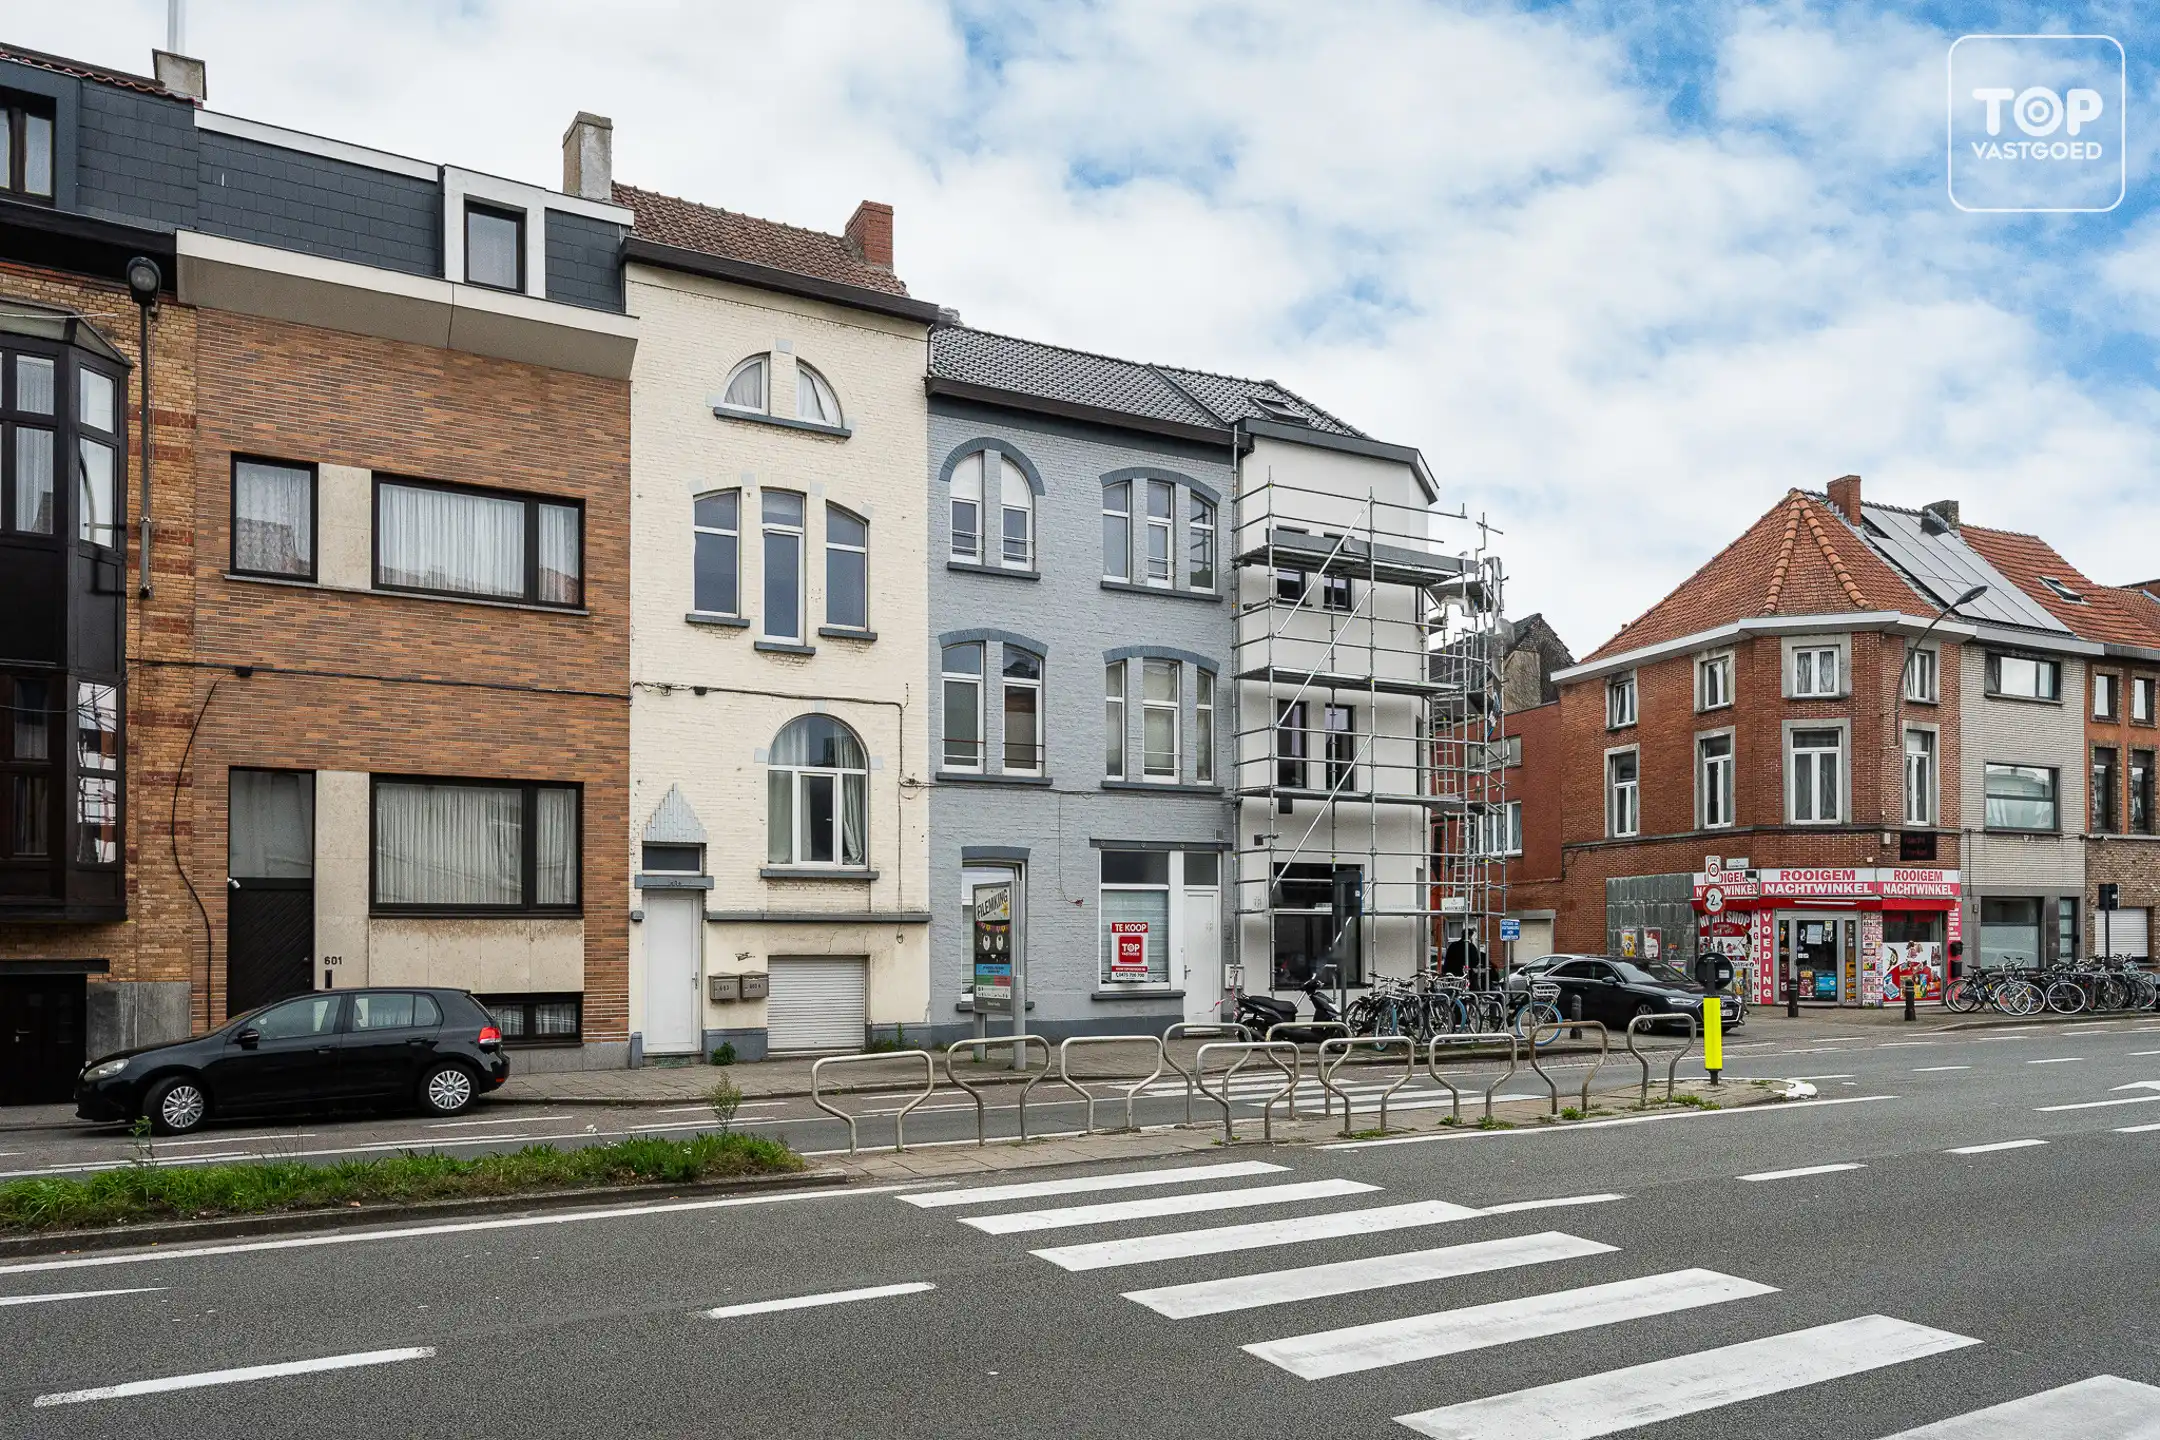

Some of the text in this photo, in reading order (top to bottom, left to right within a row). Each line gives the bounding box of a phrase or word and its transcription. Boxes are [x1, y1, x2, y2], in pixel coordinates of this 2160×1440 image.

[1780, 870, 1856, 881] ROOIGEM
[1893, 870, 1943, 881] ROOIGEM
[1765, 883, 1872, 894] NACHTWINKEL
[1883, 883, 1953, 895] NACHTWINKEL
[1727, 910, 1751, 927] SHOP
[1115, 923, 1147, 932] TE KOOP
[1121, 943, 1140, 952] TOP
[324, 956, 342, 965] 601
[1762, 913, 1771, 998] VOEDING
